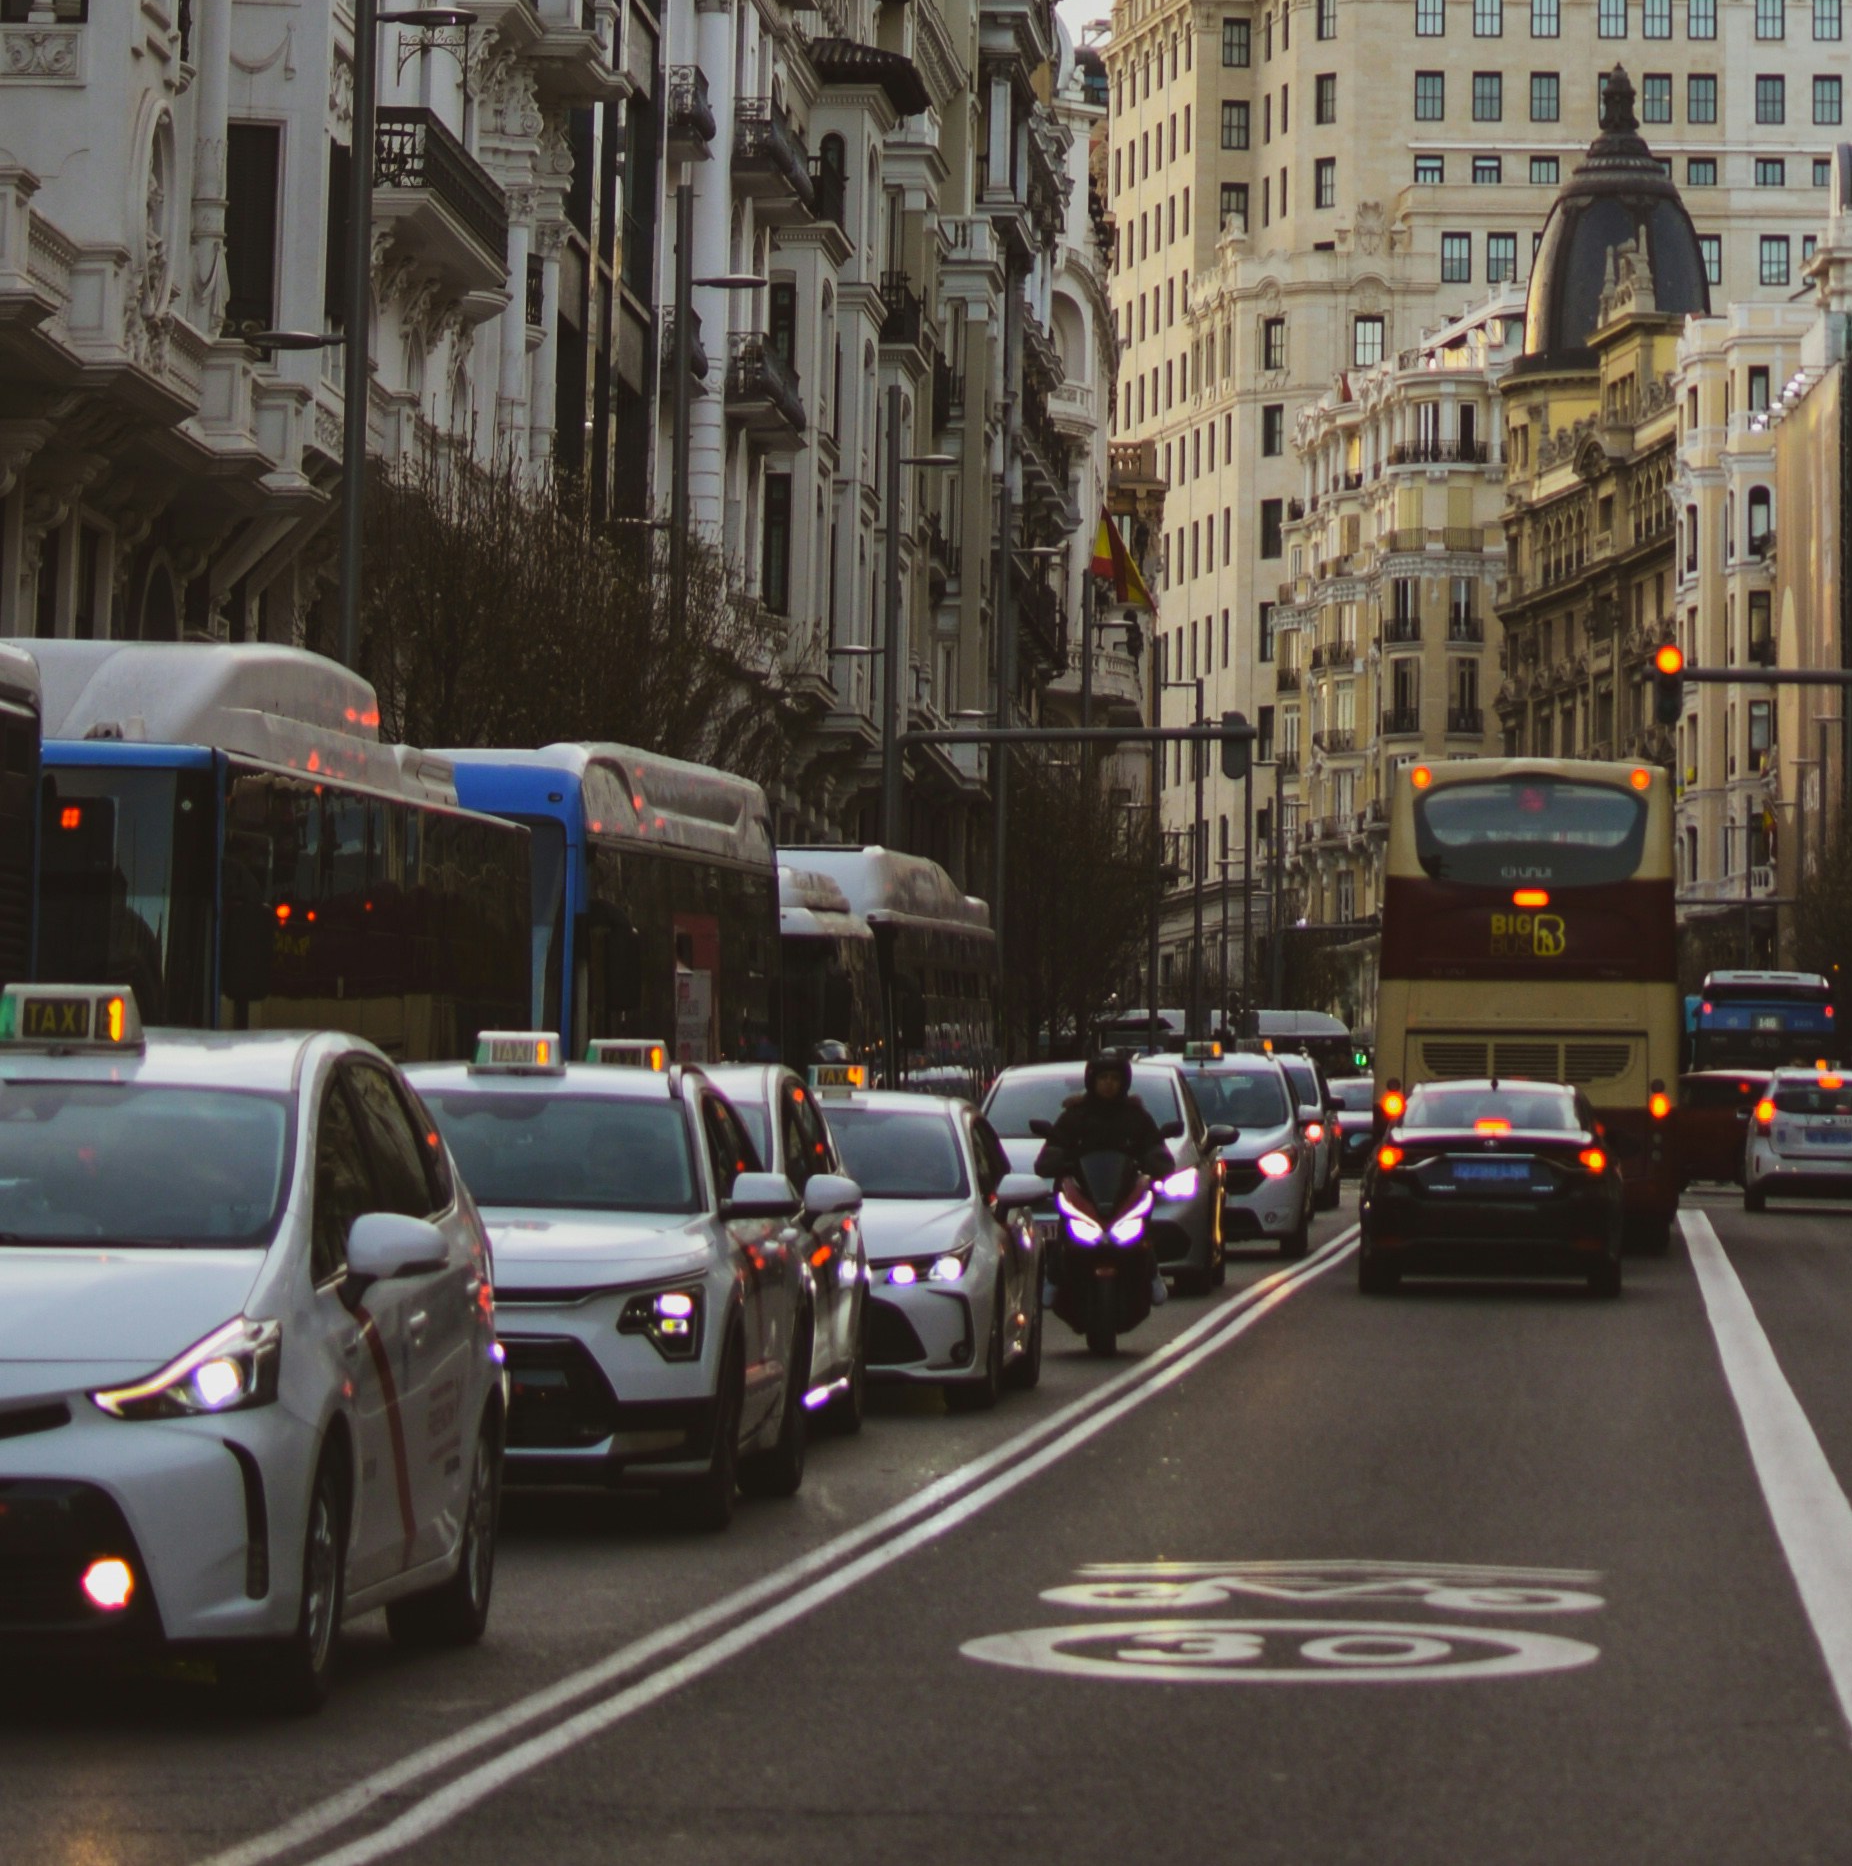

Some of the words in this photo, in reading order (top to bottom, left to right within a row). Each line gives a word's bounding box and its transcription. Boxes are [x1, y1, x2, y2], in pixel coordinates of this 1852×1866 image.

[1490, 914, 1532, 935] BIG
[1490, 936, 1532, 956] BUS
[28, 1003, 87, 1032] TAXI
[108, 998, 124, 1042] 1
[496, 1041, 532, 1063] TAXI
[1116, 1631, 1452, 1666] 30
